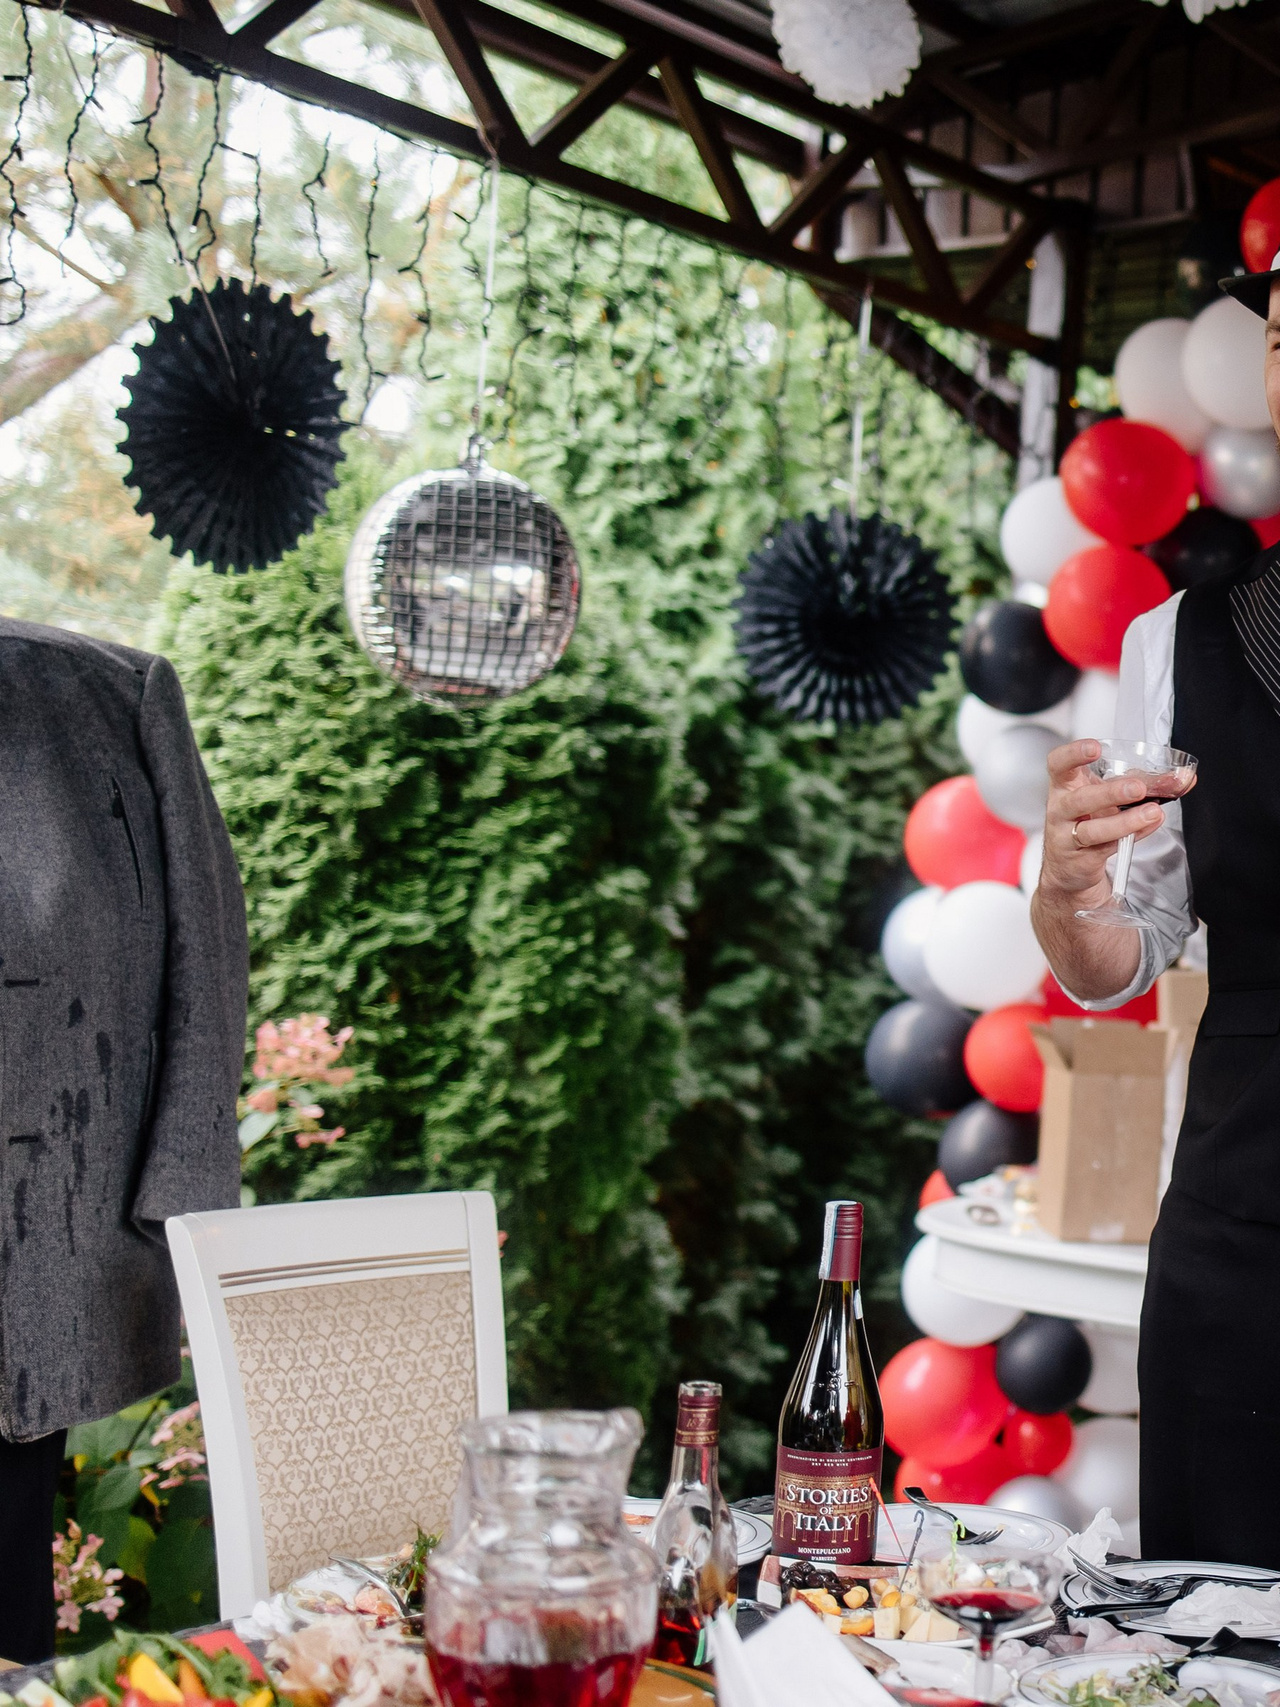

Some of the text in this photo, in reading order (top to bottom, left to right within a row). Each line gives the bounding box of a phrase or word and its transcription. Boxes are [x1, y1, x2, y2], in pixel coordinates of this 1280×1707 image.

[786, 1484, 868, 1505] STORIES
[819, 1507, 834, 1515] OF
[795, 1512, 856, 1532] ITALY
[798, 1547, 851, 1555] MONTEPULCIANO
